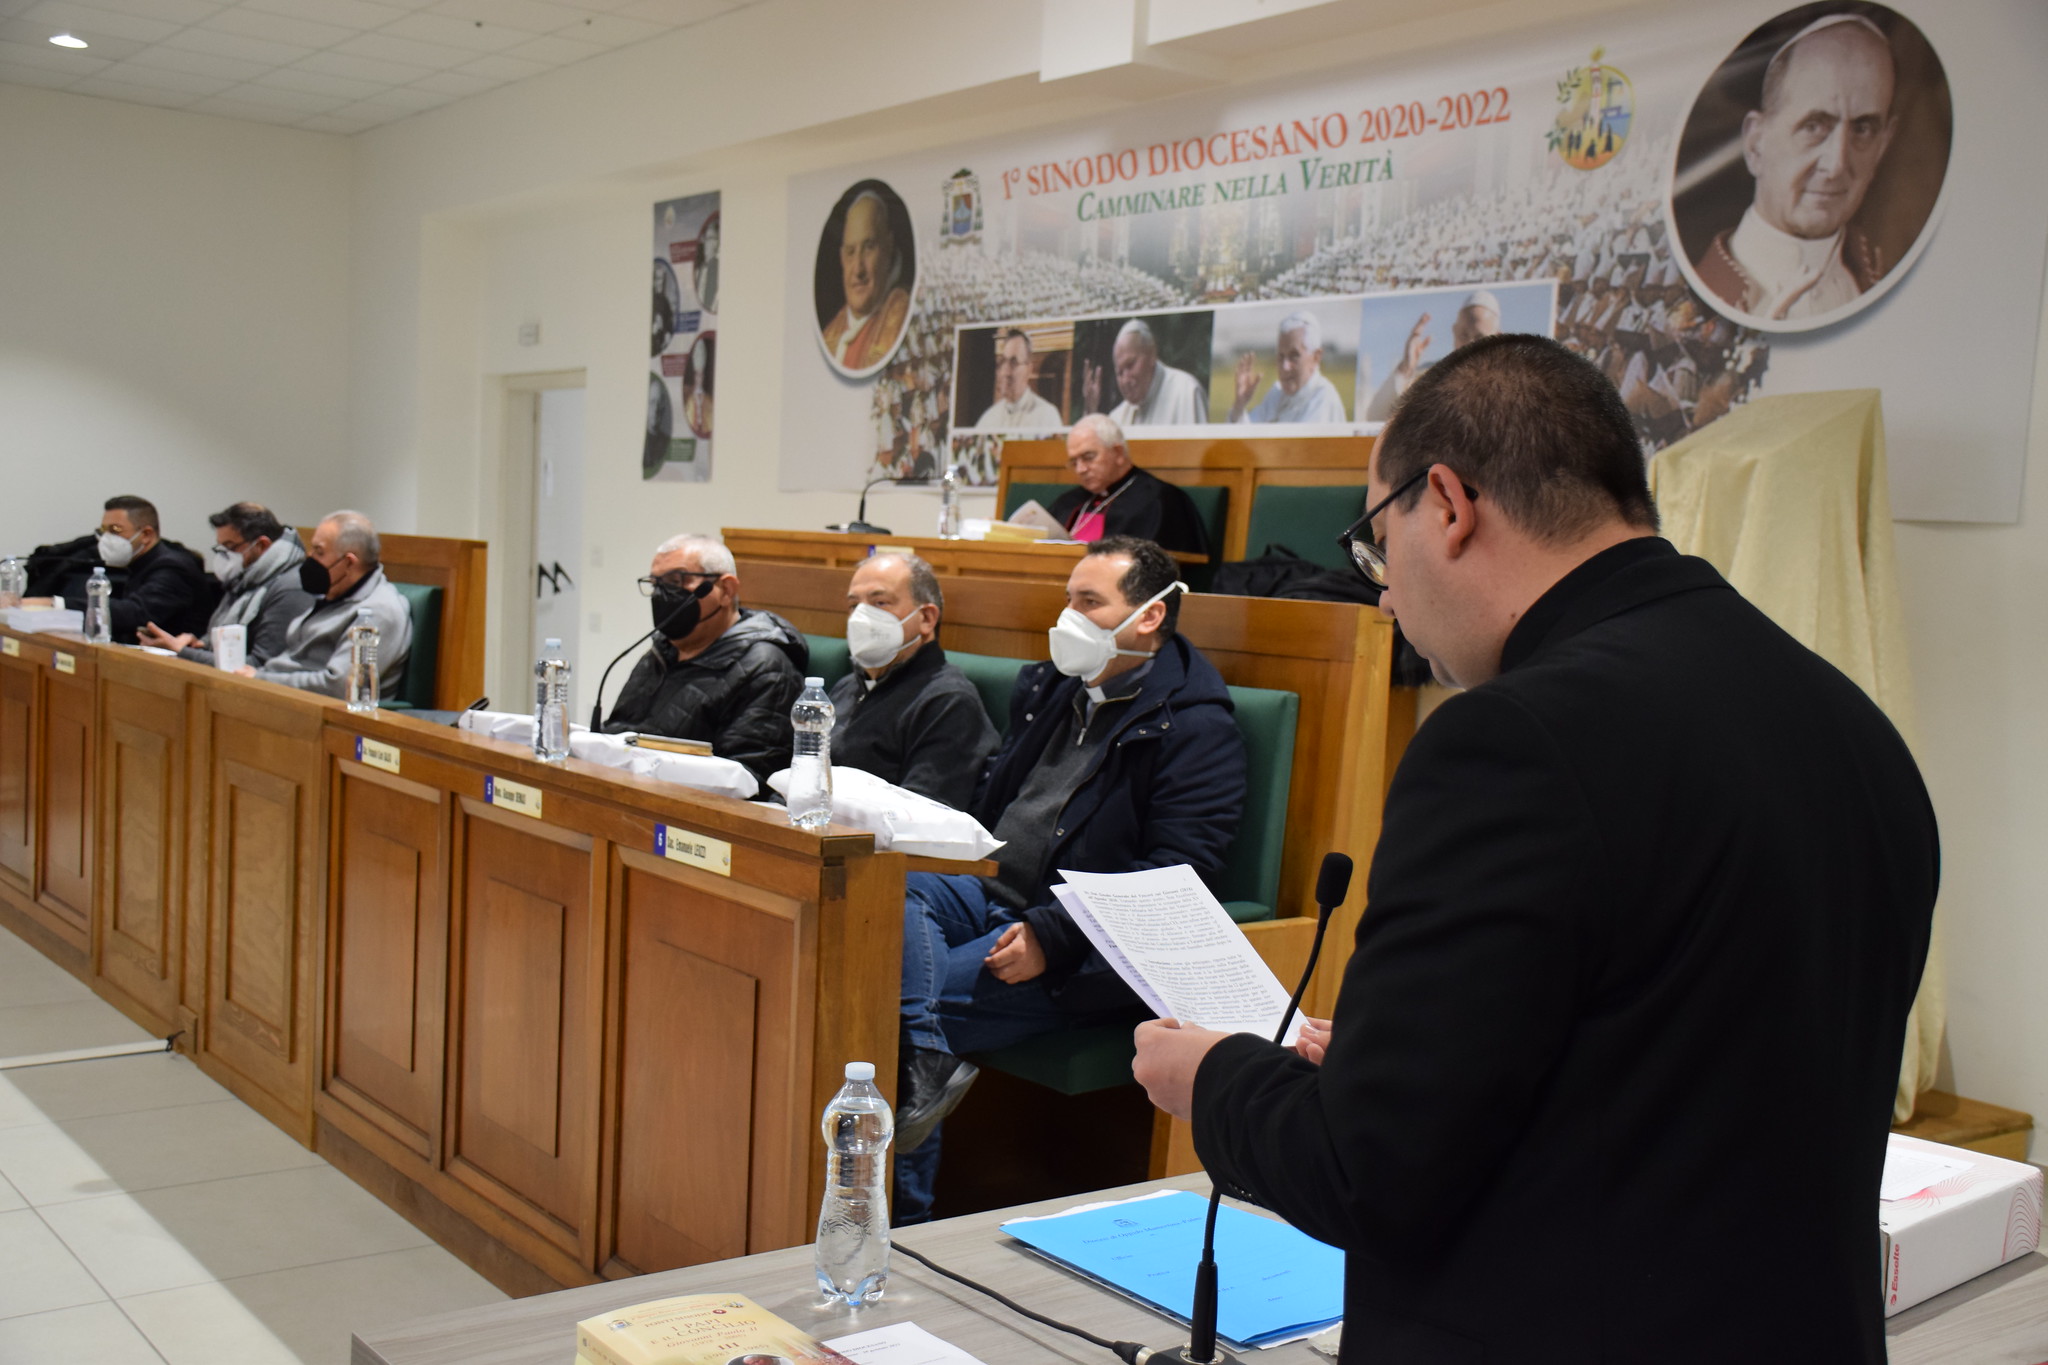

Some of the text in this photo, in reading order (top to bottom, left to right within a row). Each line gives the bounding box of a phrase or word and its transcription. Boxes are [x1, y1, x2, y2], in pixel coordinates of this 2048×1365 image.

[1026, 148, 1139, 197] SINODO
[1147, 112, 1348, 178] DIOCESANO
[1358, 86, 1512, 145] 2020-2022
[658, 832, 663, 847] 6
[676, 1319, 757, 1337] CONCILIO
[683, 1318, 722, 1329] PAPI
[667, 1335, 713, 1348] Giovanni
[717, 1342, 741, 1350] III
